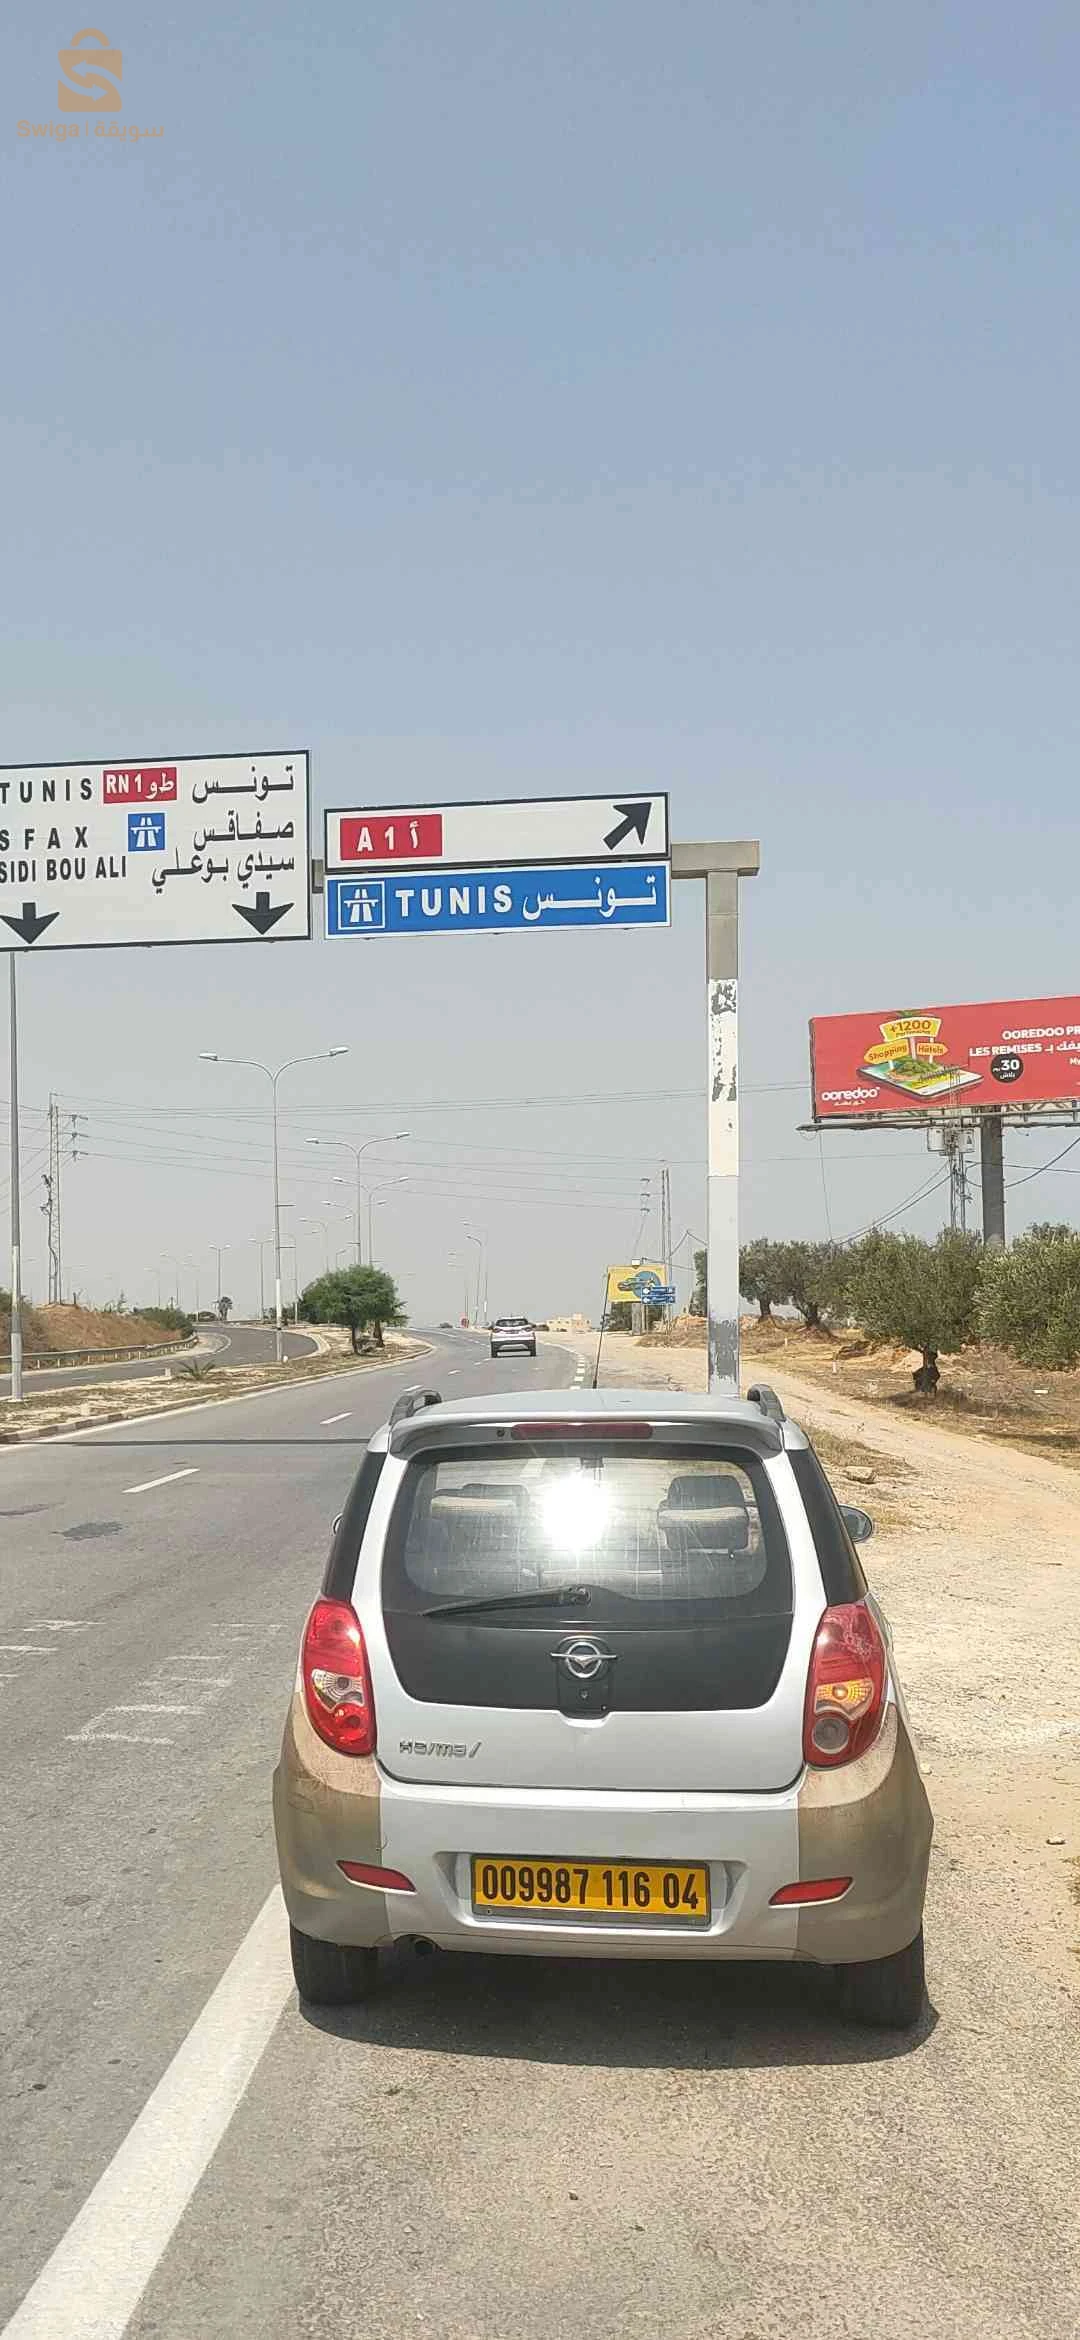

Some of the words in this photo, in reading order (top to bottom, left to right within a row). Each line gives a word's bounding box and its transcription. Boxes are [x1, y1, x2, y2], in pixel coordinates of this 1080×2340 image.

[0, 777, 93, 804] TUNIS
[106, 774, 129, 793] RN
[134, 774, 142, 792] 1
[192, 765, 294, 804] تونس
[0, 826, 88, 851] SFAX
[193, 809, 294, 851] صفاقس
[0, 859, 36, 883] SIDI
[47, 857, 86, 881] BOU
[96, 855, 126, 878] ALI
[237, 850, 295, 888] سيدي
[395, 884, 513, 917] TUNIS
[522, 875, 657, 920] تونس
[890, 1020, 932, 1033] +1200
[1002, 1026, 1065, 1040] OOREDOO
[969, 1046, 990, 1056] LES
[991, 1043, 1043, 1055] REMISES
[1001, 1059, 1020, 1071] 30
[822, 1086, 878, 1101] ooredoo
[481, 1864, 590, 1905] 009987
[602, 1869, 651, 1908] 116
[663, 1872, 699, 1910] 04
